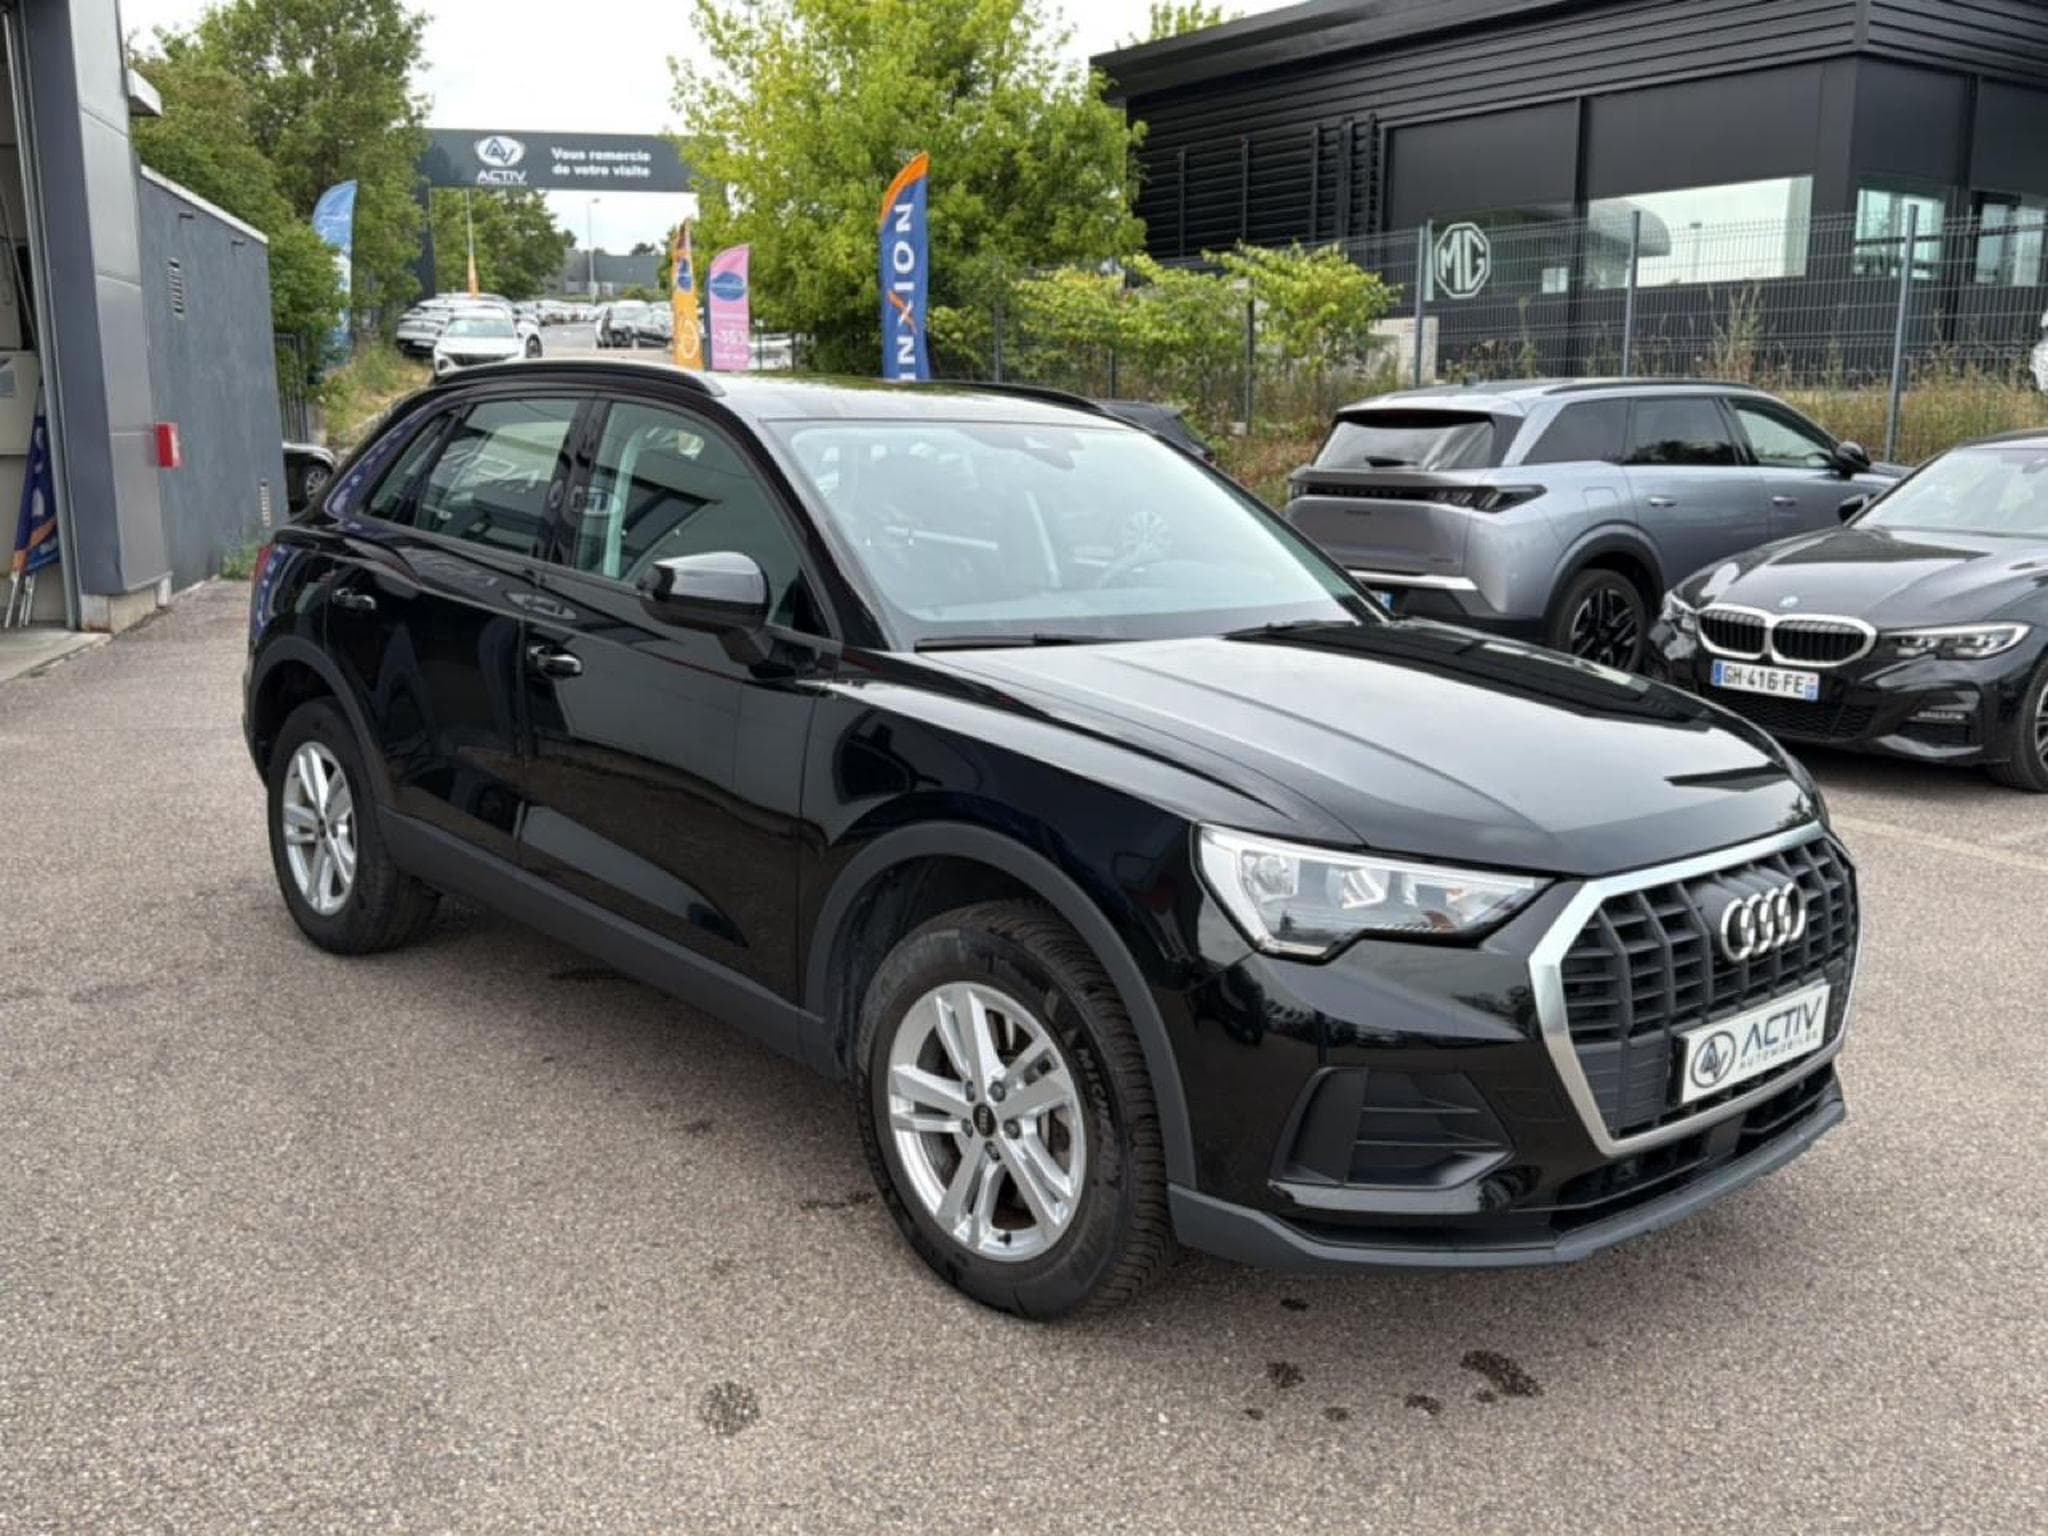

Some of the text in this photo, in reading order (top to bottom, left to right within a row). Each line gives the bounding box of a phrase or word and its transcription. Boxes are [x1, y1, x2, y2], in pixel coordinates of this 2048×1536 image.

[550, 146, 651, 161] Vous remercie
[477, 169, 527, 182] ACTIV
[551, 162, 651, 177] de votre visite
[1439, 229, 1486, 291] MG
[1741, 996, 1822, 1057] ACTIV
